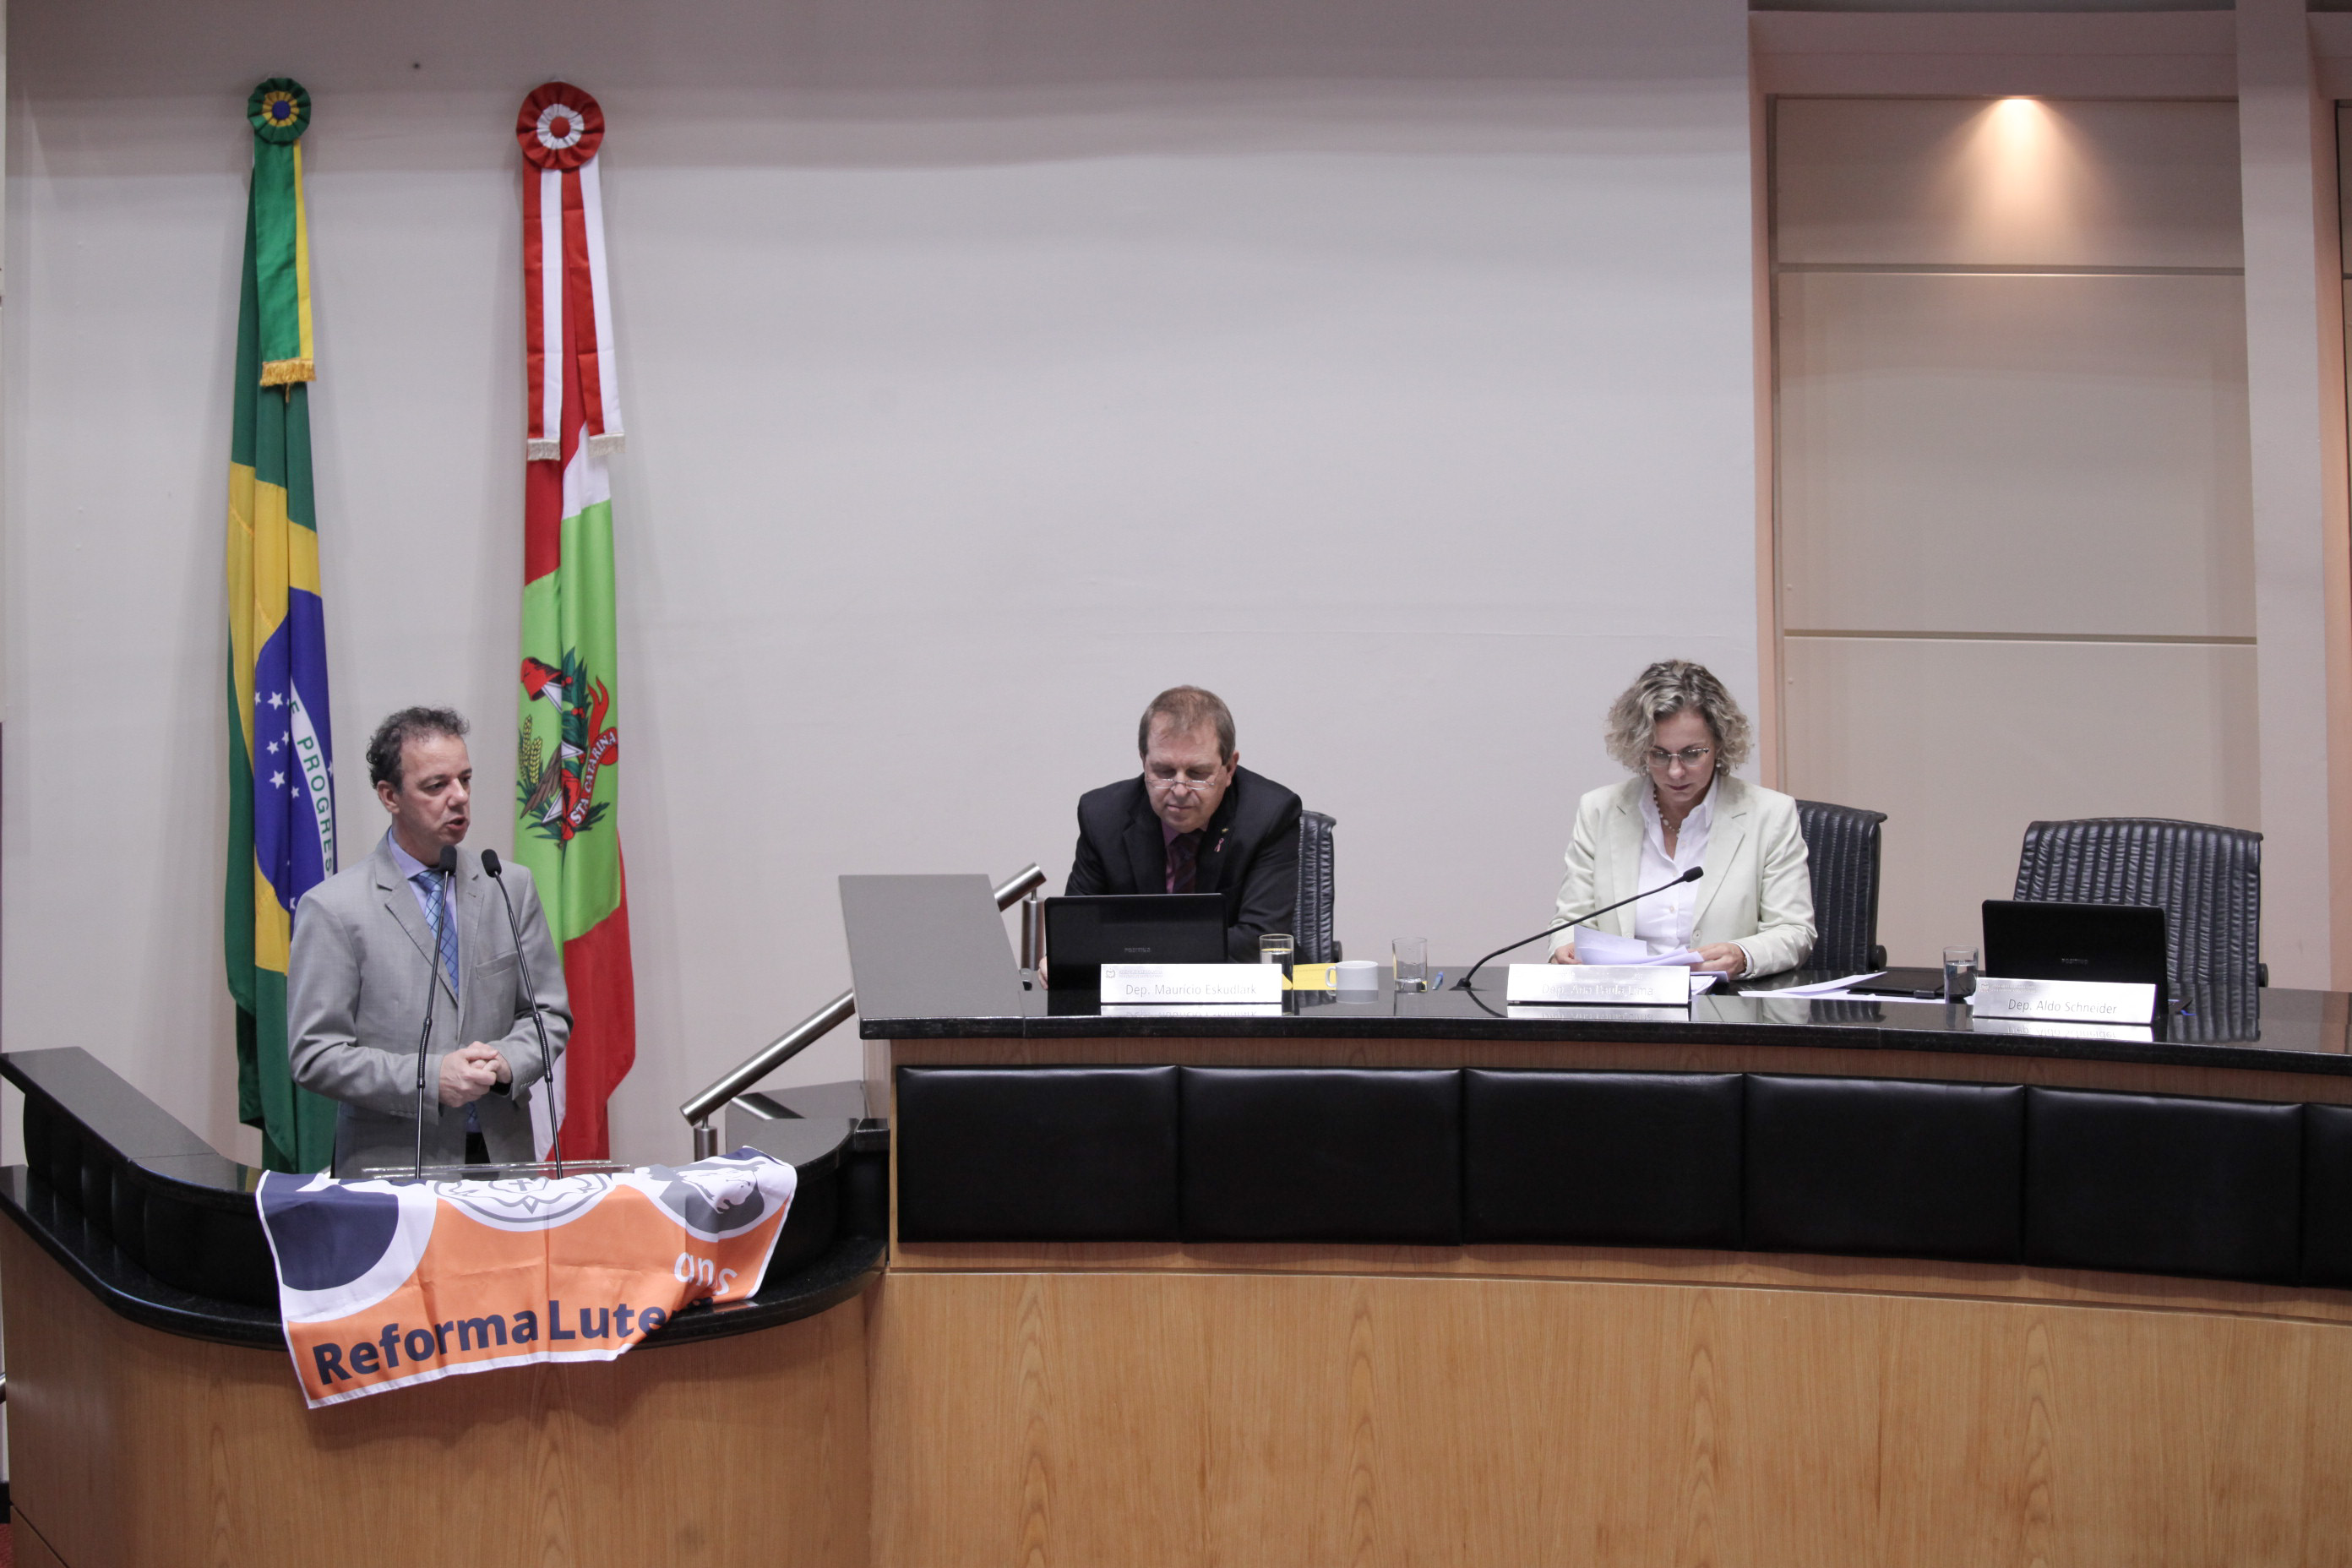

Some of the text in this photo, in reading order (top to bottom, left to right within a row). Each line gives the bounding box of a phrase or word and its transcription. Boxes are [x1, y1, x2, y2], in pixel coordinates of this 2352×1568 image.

[584, 731, 617, 792] CATARINA
[297, 736, 333, 872] PROGRES
[1126, 983, 1257, 997] Dep. Maurício Eskudlark
[2008, 999, 2117, 1014] Dep. Aldo Schneider
[674, 1252, 738, 1295] ans
[313, 1299, 667, 1386] Reforma Lute
